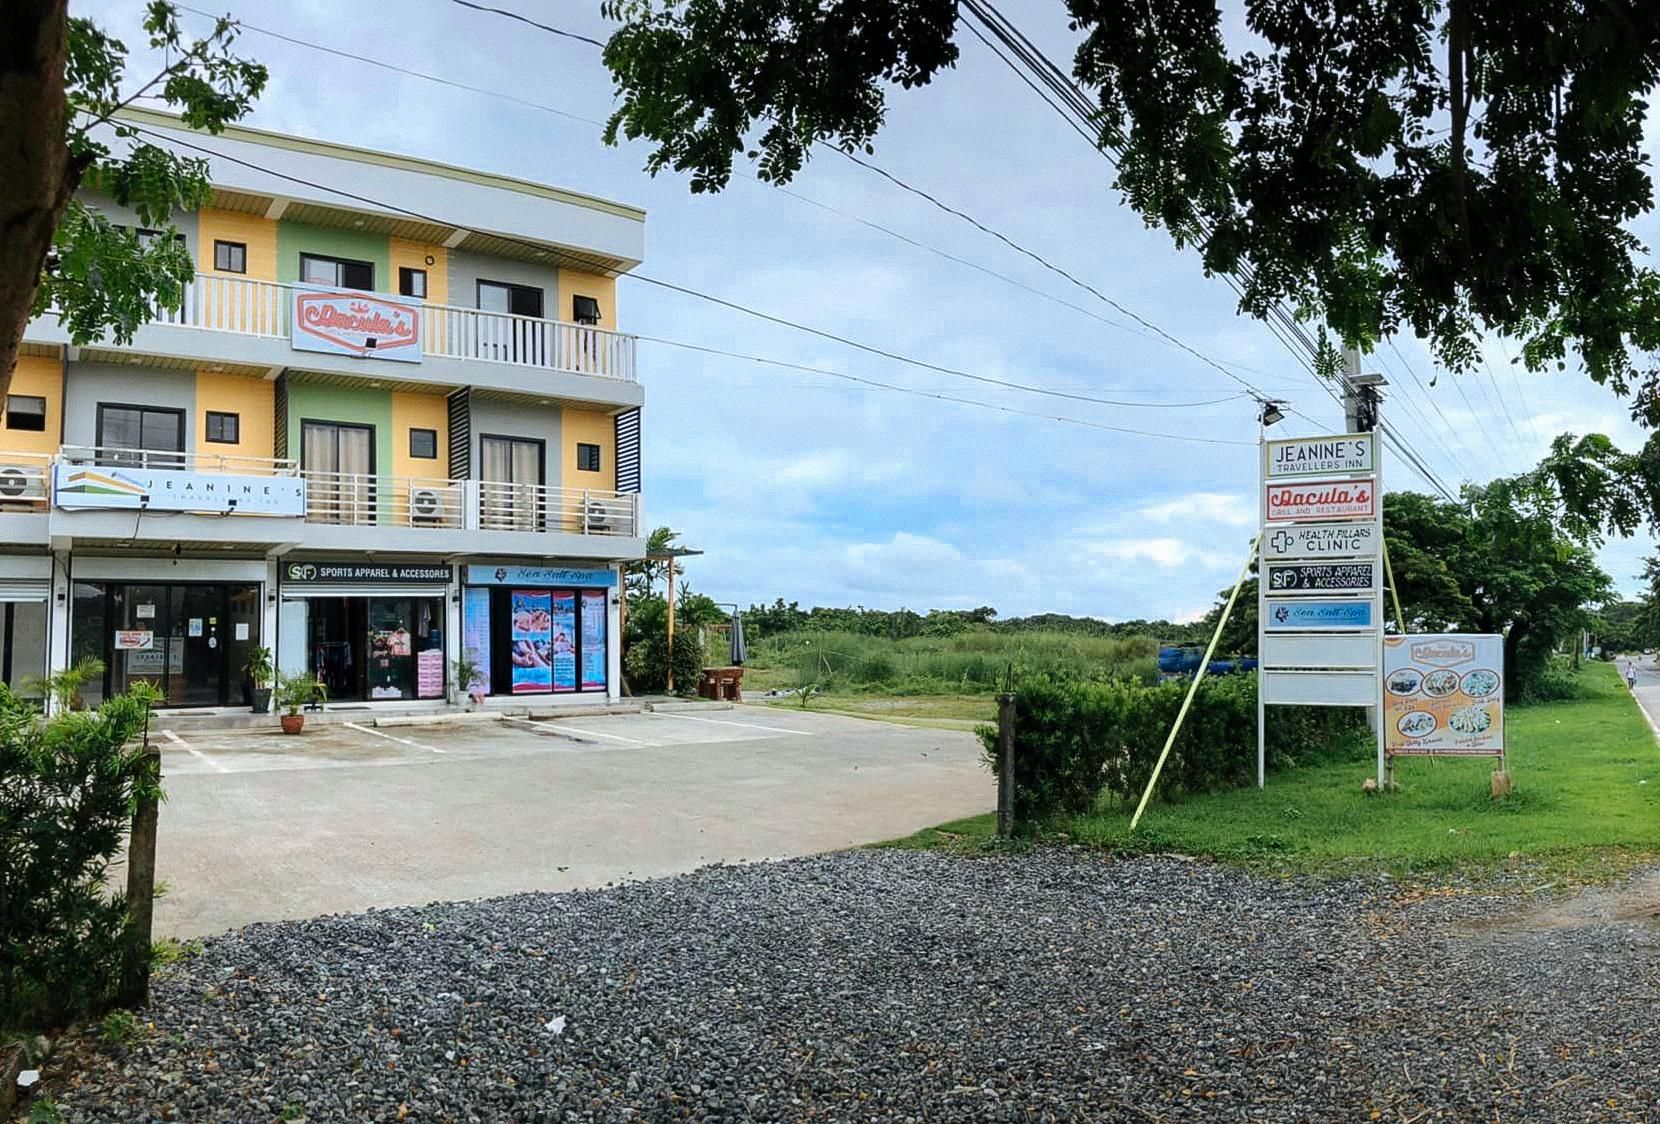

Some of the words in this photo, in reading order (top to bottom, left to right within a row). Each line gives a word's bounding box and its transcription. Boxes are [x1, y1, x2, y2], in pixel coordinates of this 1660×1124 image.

[305, 303, 412, 337] Dacula's
[1275, 440, 1366, 463] JEANINE'S
[1276, 460, 1340, 473] TRAVELLERS
[1345, 459, 1363, 469] INN
[146, 480, 303, 497] JEANINE'S
[1271, 485, 1370, 507] Dacula's
[1295, 506, 1311, 515] AND
[1316, 504, 1369, 514] RESTAURANT
[1298, 529, 1335, 540] HEALTH
[1306, 539, 1361, 551] CLINIC
[320, 567, 353, 578] SPORTS
[354, 567, 390, 578] APPAREL
[392, 569, 398, 578] &
[1300, 566, 1332, 578] SPORTS
[1334, 565, 1372, 577] APPAREL
[1302, 578, 1310, 588] &
[1314, 576, 1370, 588] ACCESSORIES
[1292, 607, 1315, 617] Sea
[1317, 606, 1343, 617] Salt
[1343, 607, 1366, 618] Spa
